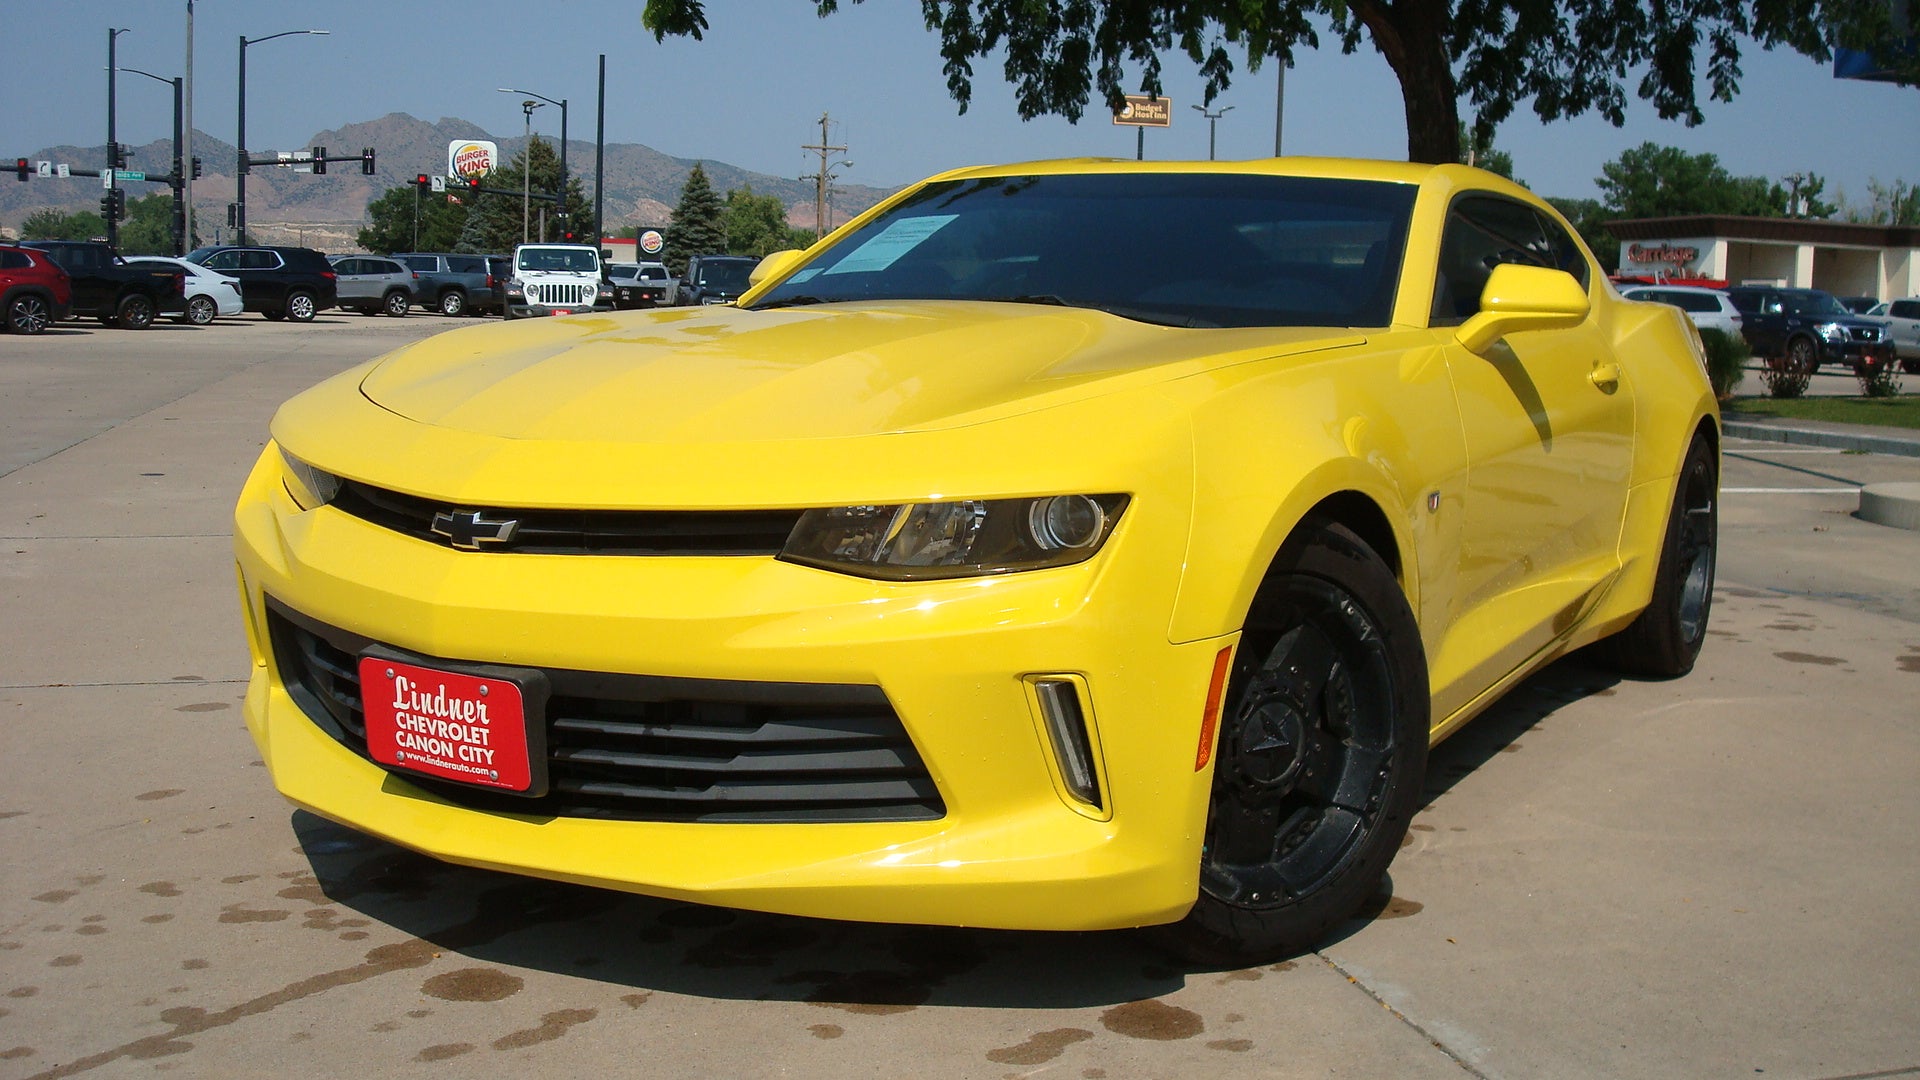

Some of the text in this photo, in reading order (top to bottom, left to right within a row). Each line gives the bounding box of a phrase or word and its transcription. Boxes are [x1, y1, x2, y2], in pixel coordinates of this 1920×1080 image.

[1135, 103, 1162, 112] Budget
[1135, 110, 1167, 119] Host Inn
[456, 149, 489, 164] BURGER
[458, 158, 490, 174] KING
[1628, 243, 1696, 266] Carriage
[392, 675, 490, 725] Lindner
[395, 712, 490, 746] CHEVROLET
[395, 731, 494, 765] CANON CITY
[405, 752, 490, 776] www.lindnerauto.com
